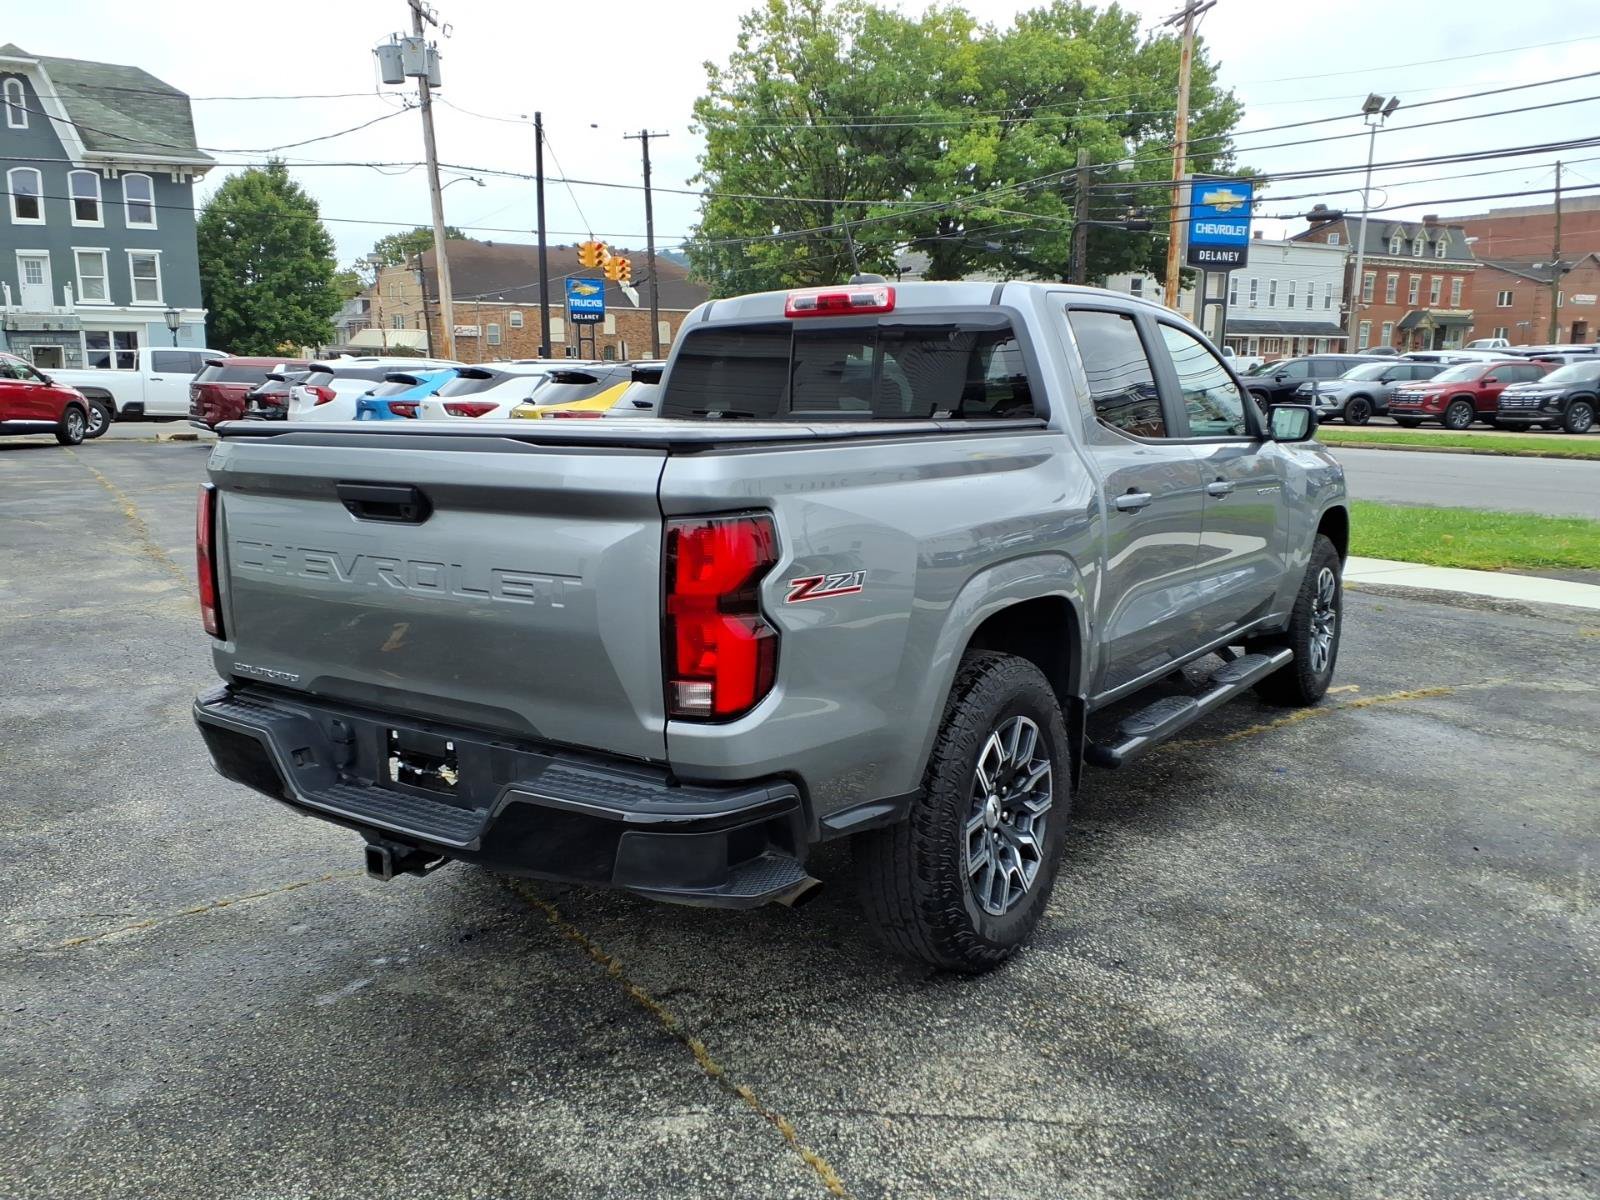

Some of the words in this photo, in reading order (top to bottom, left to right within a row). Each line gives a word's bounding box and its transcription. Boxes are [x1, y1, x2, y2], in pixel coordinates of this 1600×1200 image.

[1195, 223, 1247, 236] CHEVROLET
[1199, 250, 1239, 261] DELANEY
[569, 298, 603, 307] TRUCKS
[235, 540, 584, 608] CHEVROLET
[786, 570, 866, 603] Z71
